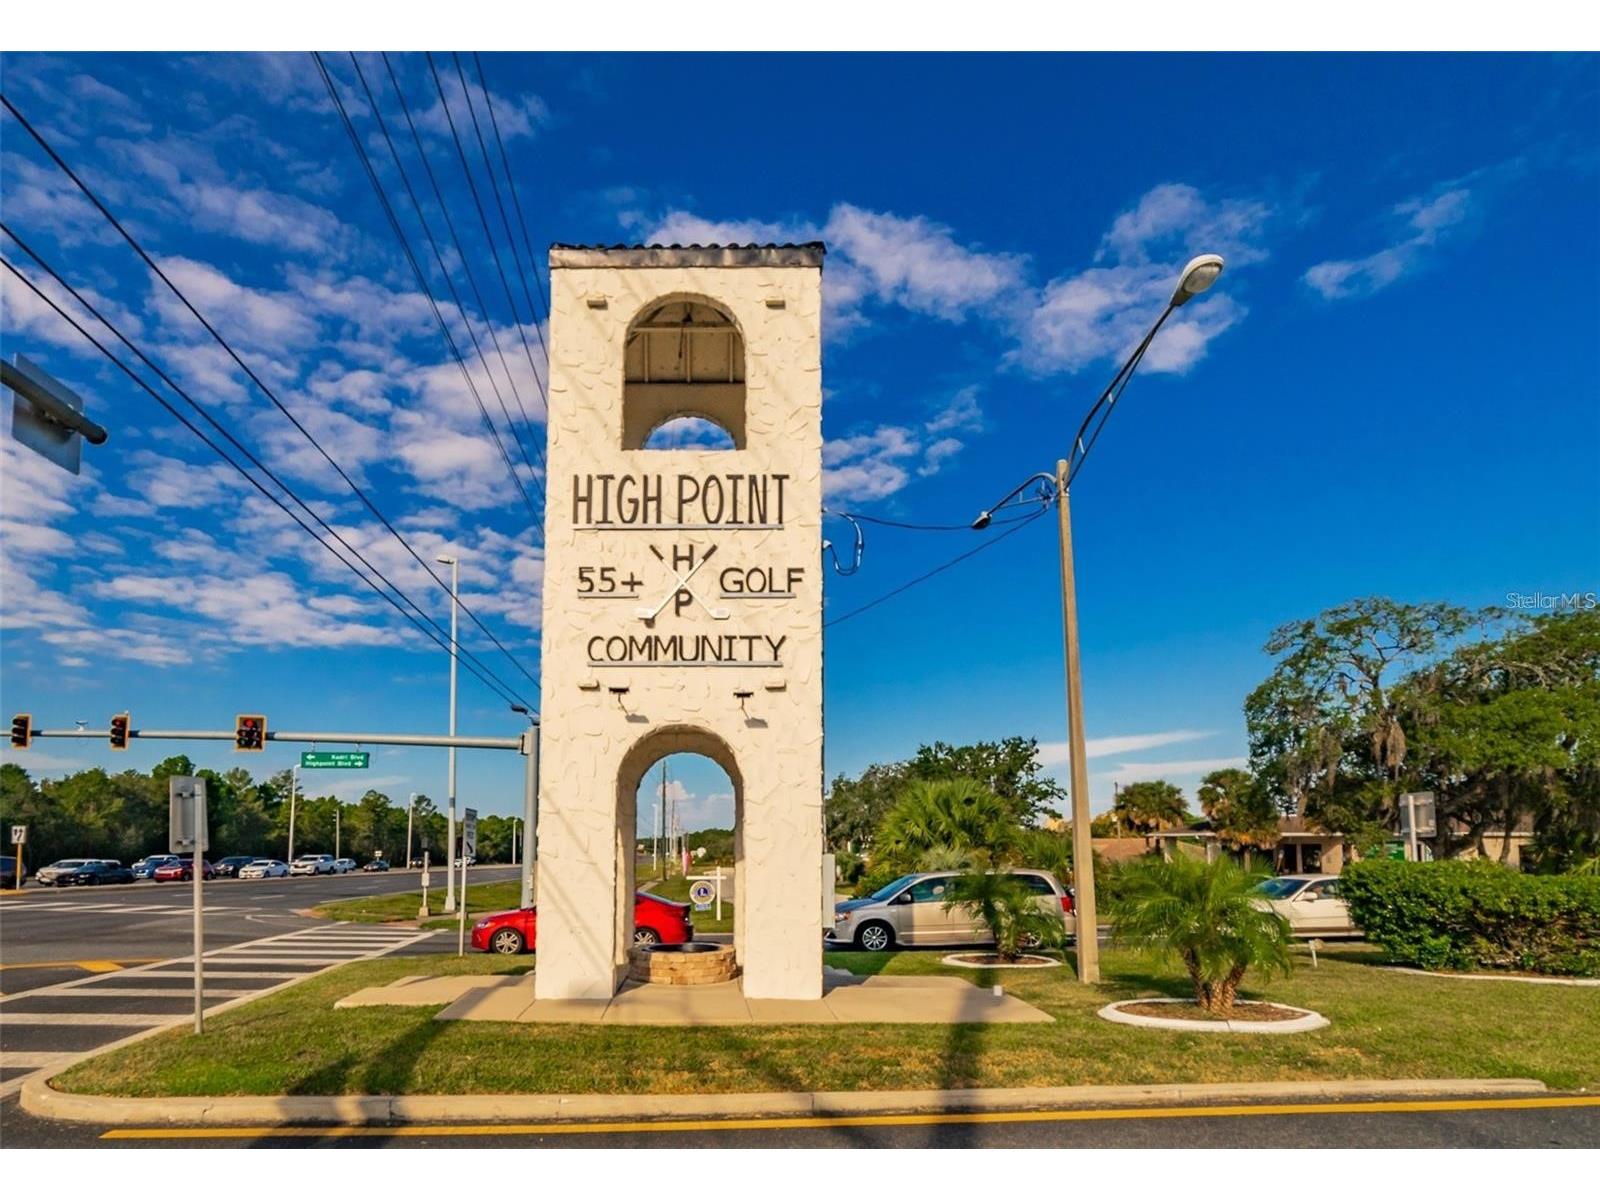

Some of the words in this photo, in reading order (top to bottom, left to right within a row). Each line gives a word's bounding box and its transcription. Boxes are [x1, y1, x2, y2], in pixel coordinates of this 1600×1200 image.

[572, 474, 662, 525] HIGH
[677, 474, 790, 525] POINT
[577, 566, 644, 593] 55+
[719, 566, 805, 593] GOLF
[587, 635, 787, 662] COMMUNITY
